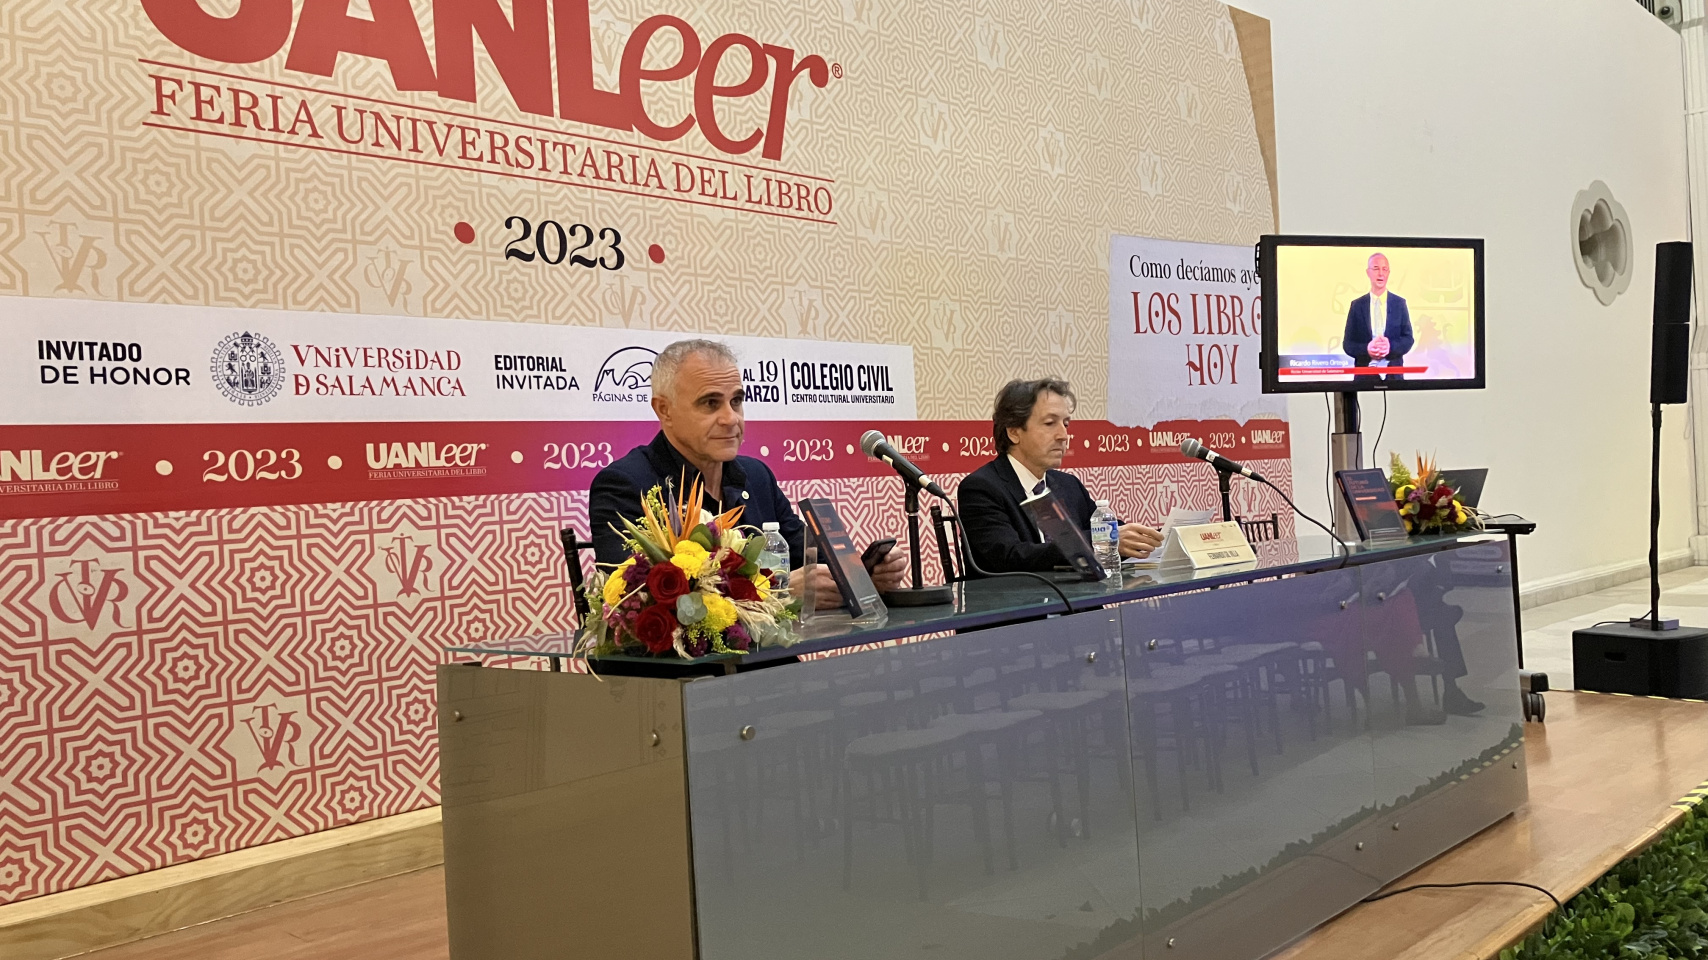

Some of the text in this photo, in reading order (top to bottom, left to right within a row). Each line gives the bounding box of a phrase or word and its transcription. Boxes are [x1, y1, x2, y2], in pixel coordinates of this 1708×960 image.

[148, 73, 833, 216] FERIA UNIVERSITARIA DEL LIBRO
[504, 216, 626, 271] 2023
[1129, 254, 1260, 290] Como decíamos aye
[1131, 291, 1262, 337] LOS LIBRO
[38, 339, 142, 362] INVITADO
[494, 354, 566, 372] EDITORIAL
[742, 360, 778, 382] AL 19
[1185, 343, 1239, 386] HOY
[1290, 359, 1349, 368] Ricardo Rivero Ortega
[40, 365, 191, 386] DE HONOR
[316, 373, 467, 397] SALAMANCA
[496, 374, 580, 390] INVITADA
[790, 361, 893, 391] COLEGIO CIVIL
[592, 391, 649, 402] PÁGINAS DE
[743, 385, 779, 402] ARZO
[791, 393, 895, 404] CENTRO CULTURAL UNIVERSITARIO
[887, 435, 930, 453] NLeer
[1098, 434, 1130, 452] 2023
[1209, 432, 1235, 449] 2023
[1251, 430, 1285, 444] UANLeer
[366, 442, 486, 469] UANLeer
[543, 442, 614, 470] 2023
[783, 438, 834, 462] 2023
[0, 449, 119, 481] NLeer
[203, 448, 302, 482] 2023
[369, 471, 392, 479] FERIA
[393, 469, 450, 478] UNIVERSITARIA
[466, 467, 487, 475] LIBRO
[0, 481, 119, 493] VERSITARIA DEL LIBRO
